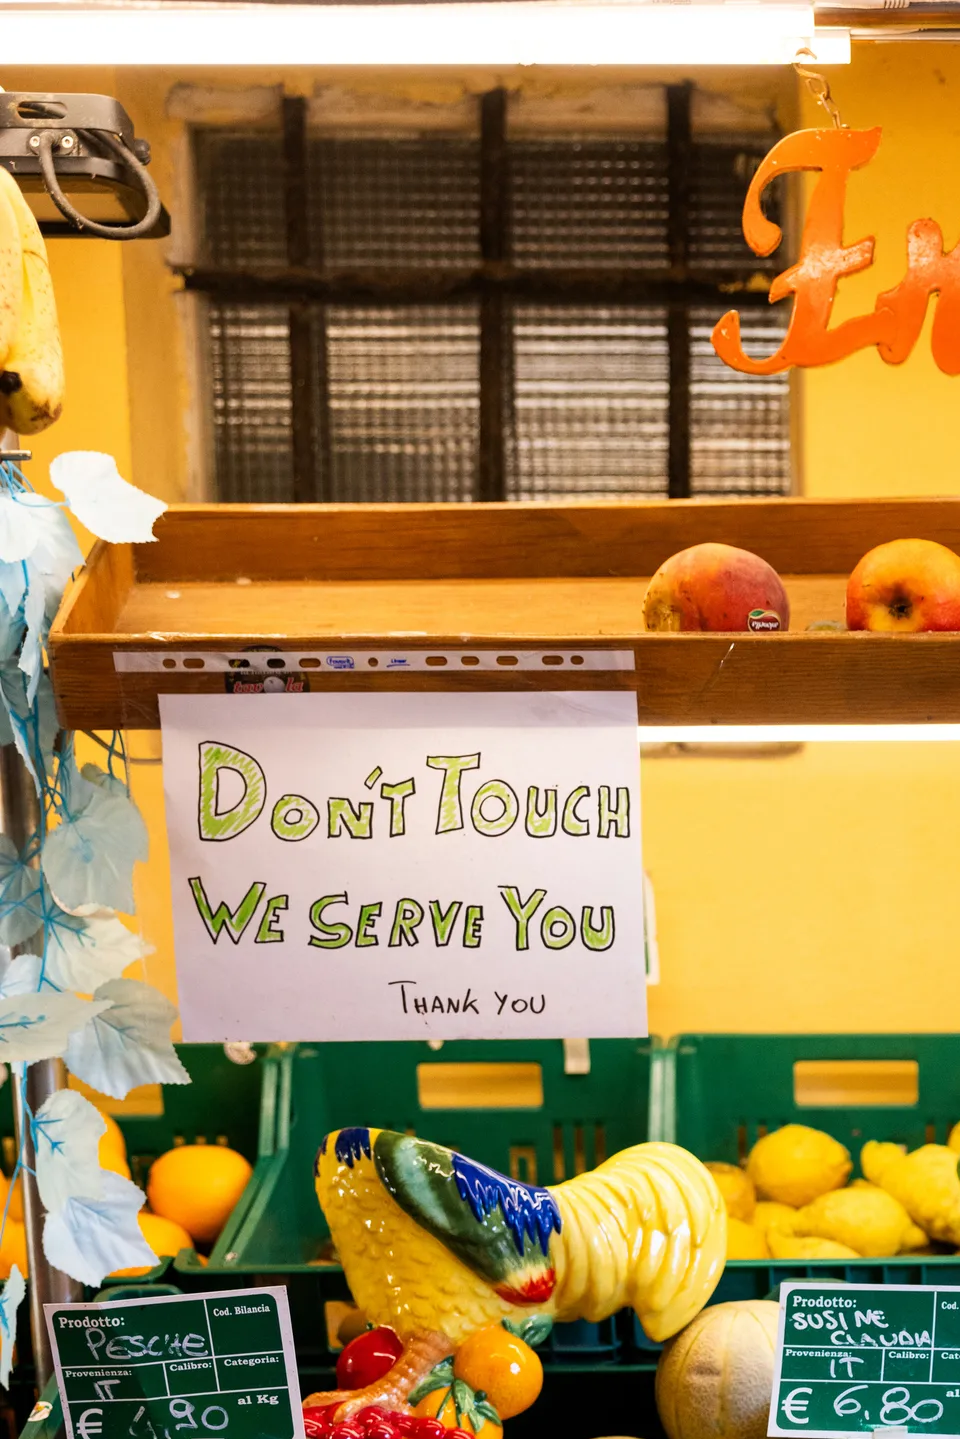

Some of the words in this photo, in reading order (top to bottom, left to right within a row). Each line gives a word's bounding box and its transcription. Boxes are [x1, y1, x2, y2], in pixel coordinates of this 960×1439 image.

[426, 752, 631, 839] TOUCH
[188, 876, 289, 945] WE
[308, 891, 484, 948] SERVE
[498, 885, 616, 952] YOU
[388, 980, 480, 1016] THANK
[494, 990, 546, 1016] YOU
[792, 1295, 857, 1309] Prodotto:
[941, 1301, 960, 1311] Cod.
[213, 1307, 232, 1317] Cod.
[234, 1304, 270, 1316] Bilancia
[58, 1315, 125, 1329] Prodotto:
[85, 1327, 209, 1360] PESCHE
[830, 1328, 933, 1348] CLAUDIA
[785, 1349, 852, 1359] Provenienza:
[888, 1351, 929, 1360] Calibro:
[169, 1360, 212, 1372] Calibro:
[224, 1356, 279, 1367] Categoria:
[830, 1357, 864, 1378] IT
[65, 1368, 132, 1378] Provenienza:
[93, 1379, 121, 1400] IT
[946, 1389, 960, 1398] al
[237, 1396, 252, 1406] al
[256, 1394, 280, 1406] Kg
[781, 1387, 813, 1424] €
